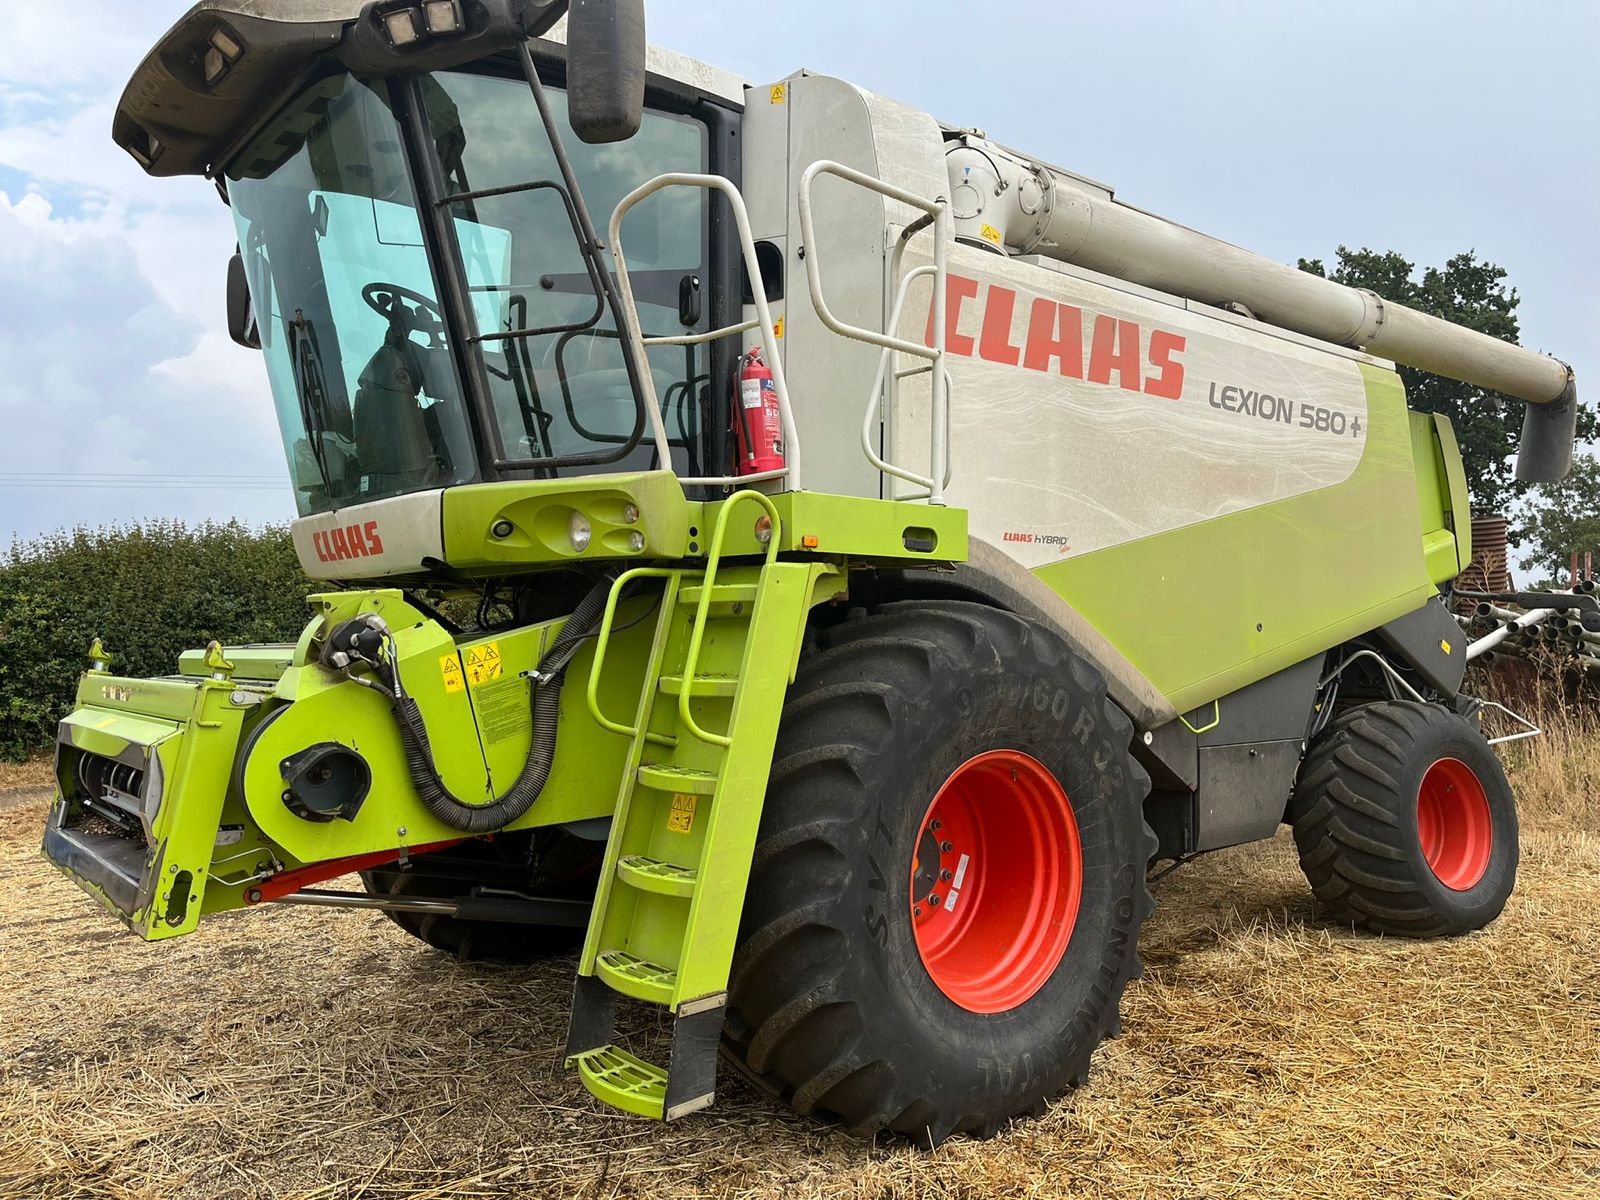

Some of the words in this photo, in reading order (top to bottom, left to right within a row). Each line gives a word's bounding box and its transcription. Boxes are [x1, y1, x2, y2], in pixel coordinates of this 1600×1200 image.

[924, 273, 1186, 400] CLAAS
[1208, 381, 1294, 425] LEXION
[313, 520, 384, 562] CLAAS
[1003, 532, 1033, 543] CLAAS
